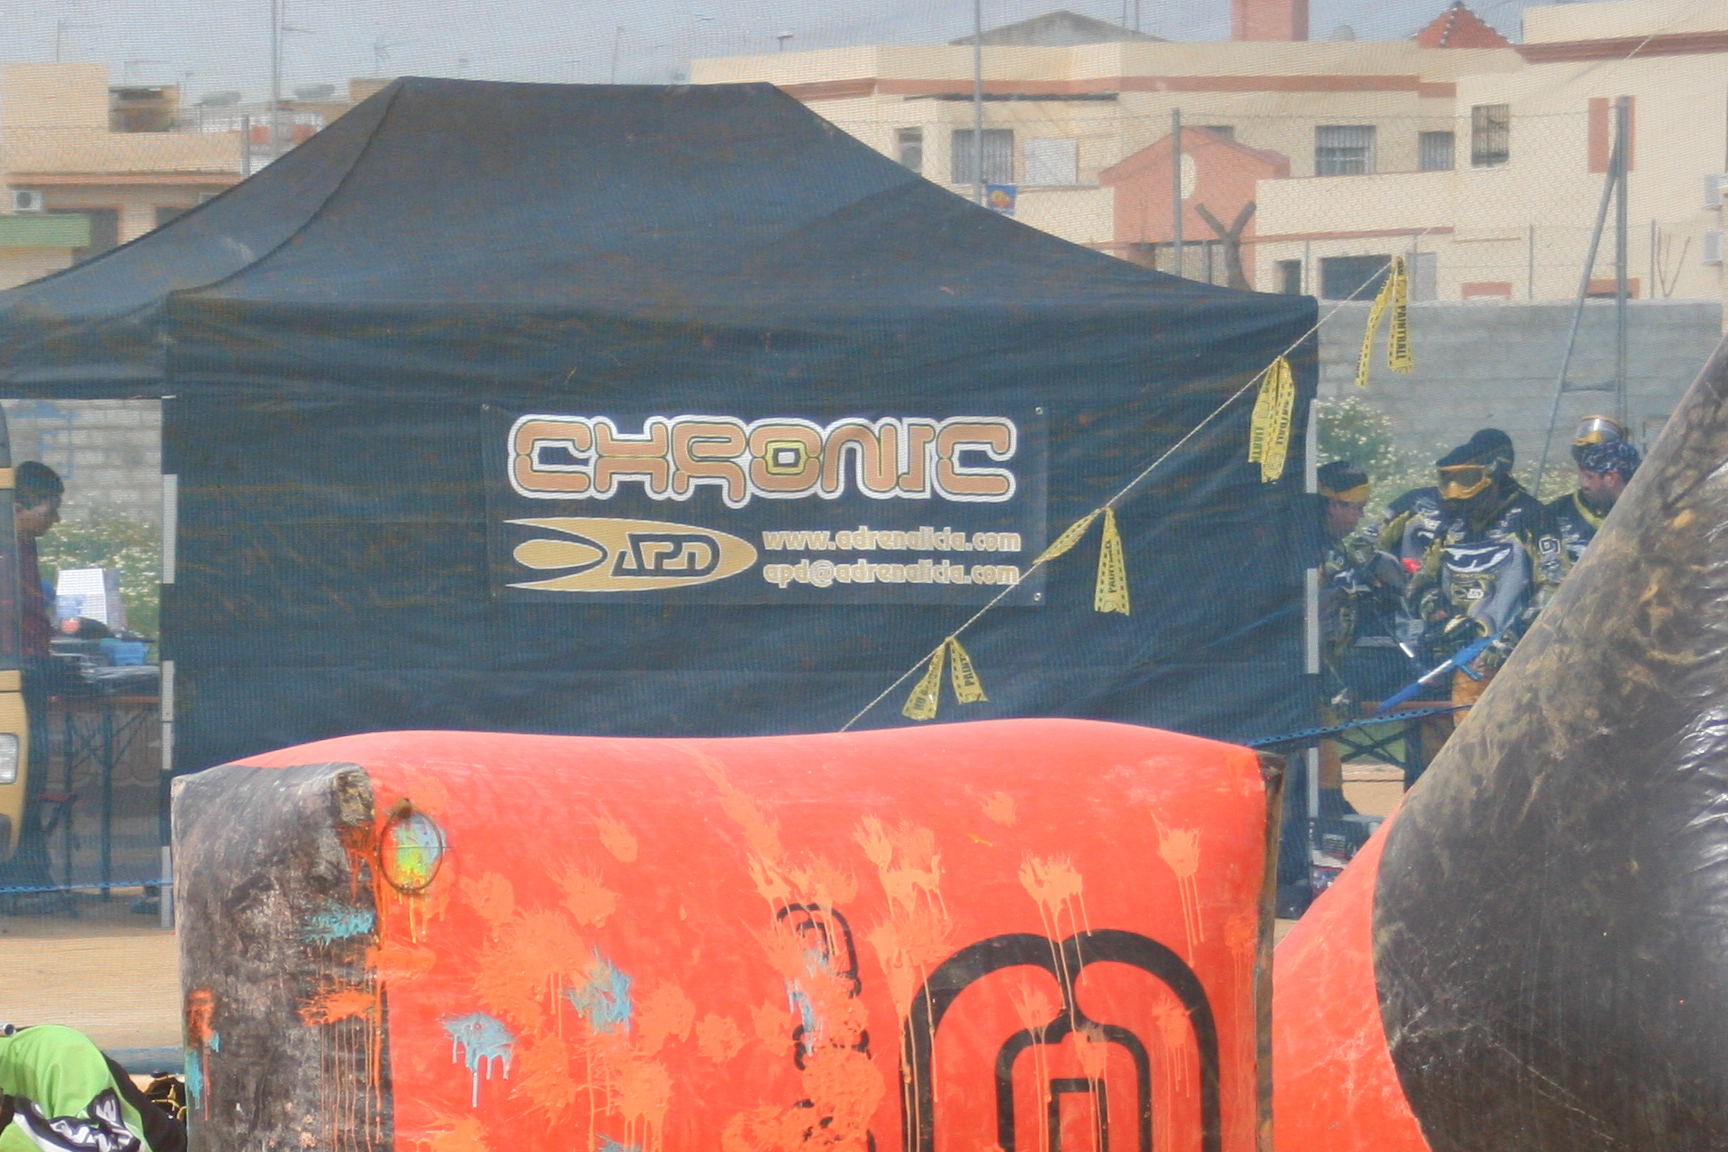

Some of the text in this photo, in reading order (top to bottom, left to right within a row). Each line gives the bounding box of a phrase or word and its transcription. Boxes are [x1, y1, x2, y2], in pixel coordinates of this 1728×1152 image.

[508, 415, 1017, 509] CHRONIC
[762, 526, 1021, 551] www.adrenalicia.com
[763, 560, 1020, 588] apd@adrenalicia.com
